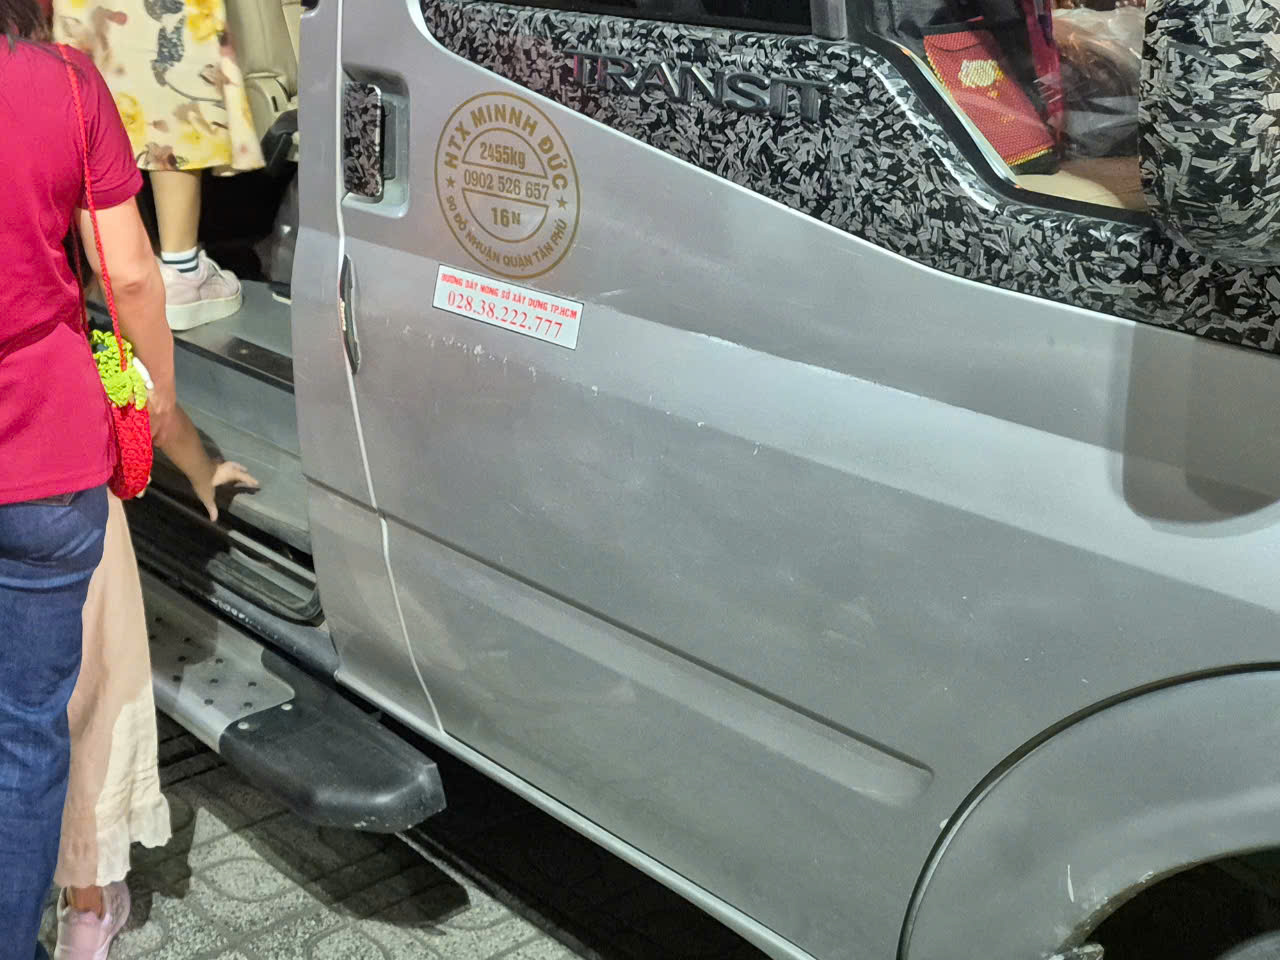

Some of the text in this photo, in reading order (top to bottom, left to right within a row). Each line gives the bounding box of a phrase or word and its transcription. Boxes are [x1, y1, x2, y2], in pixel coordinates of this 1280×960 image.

[562, 46, 834, 123] TRANSIT
[444, 121, 472, 169] HTX
[463, 169, 550, 201] 0902 526 657
[447, 290, 563, 339] 028.38.222.777
